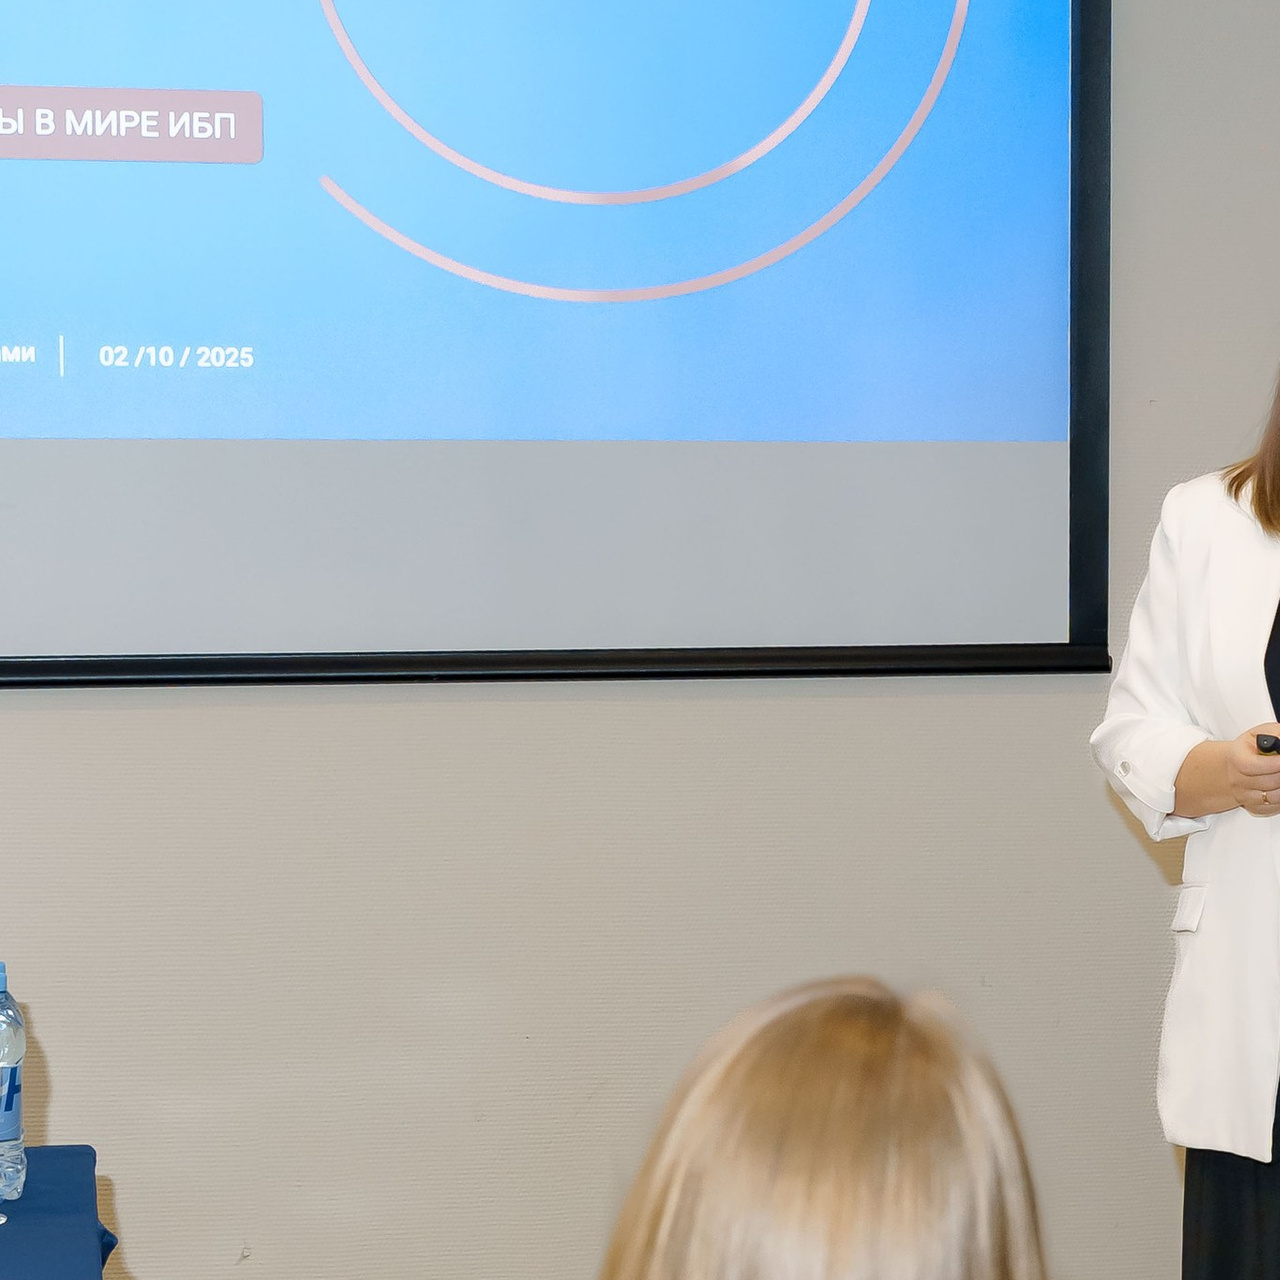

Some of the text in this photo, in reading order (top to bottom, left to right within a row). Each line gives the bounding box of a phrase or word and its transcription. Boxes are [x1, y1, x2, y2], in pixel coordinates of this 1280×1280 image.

[35, 108, 56, 136] В
[65, 109, 160, 138] МИРЕ
[168, 111, 236, 139] ИБП
[0, 345, 36, 363] ми
[196, 346, 255, 368] 2025
